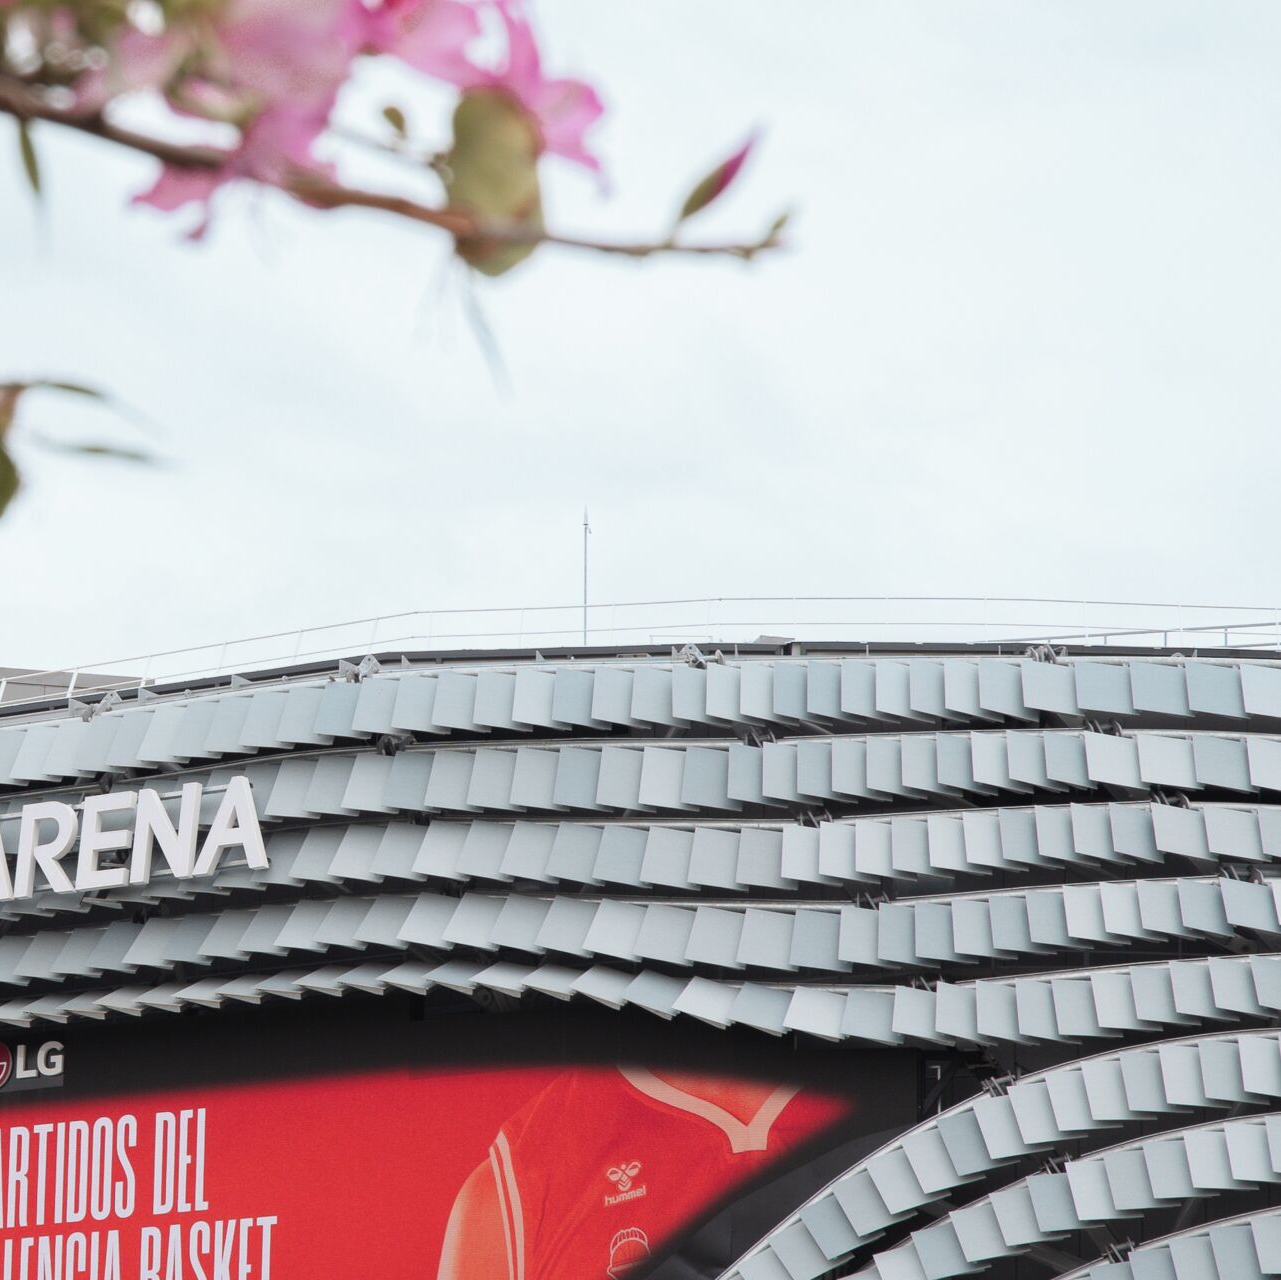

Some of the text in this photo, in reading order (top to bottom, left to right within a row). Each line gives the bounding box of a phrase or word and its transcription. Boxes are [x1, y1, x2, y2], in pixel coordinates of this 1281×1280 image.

[15, 1040, 64, 1079] LG
[152, 1107, 210, 1215] DEL
[604, 1184, 646, 1207] hummel
